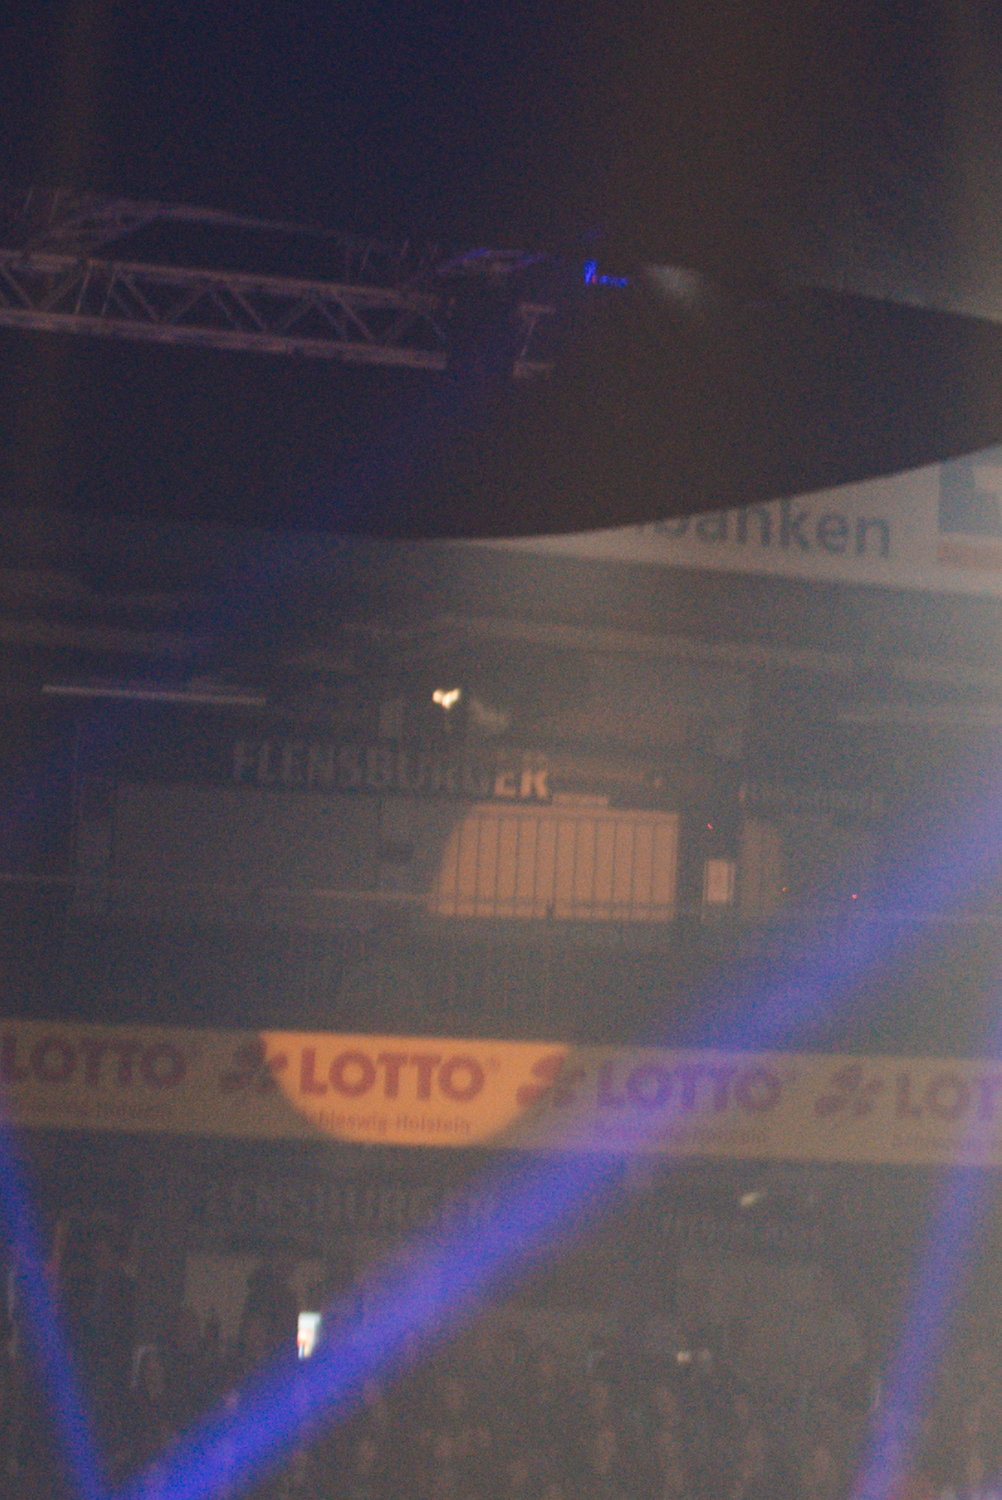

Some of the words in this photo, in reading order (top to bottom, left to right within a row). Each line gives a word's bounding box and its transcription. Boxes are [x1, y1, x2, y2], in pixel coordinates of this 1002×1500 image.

[1, 1032, 187, 1090] LOTTO
[300, 1046, 485, 1101] LOTTO
[596, 1061, 781, 1113] LOTTO
